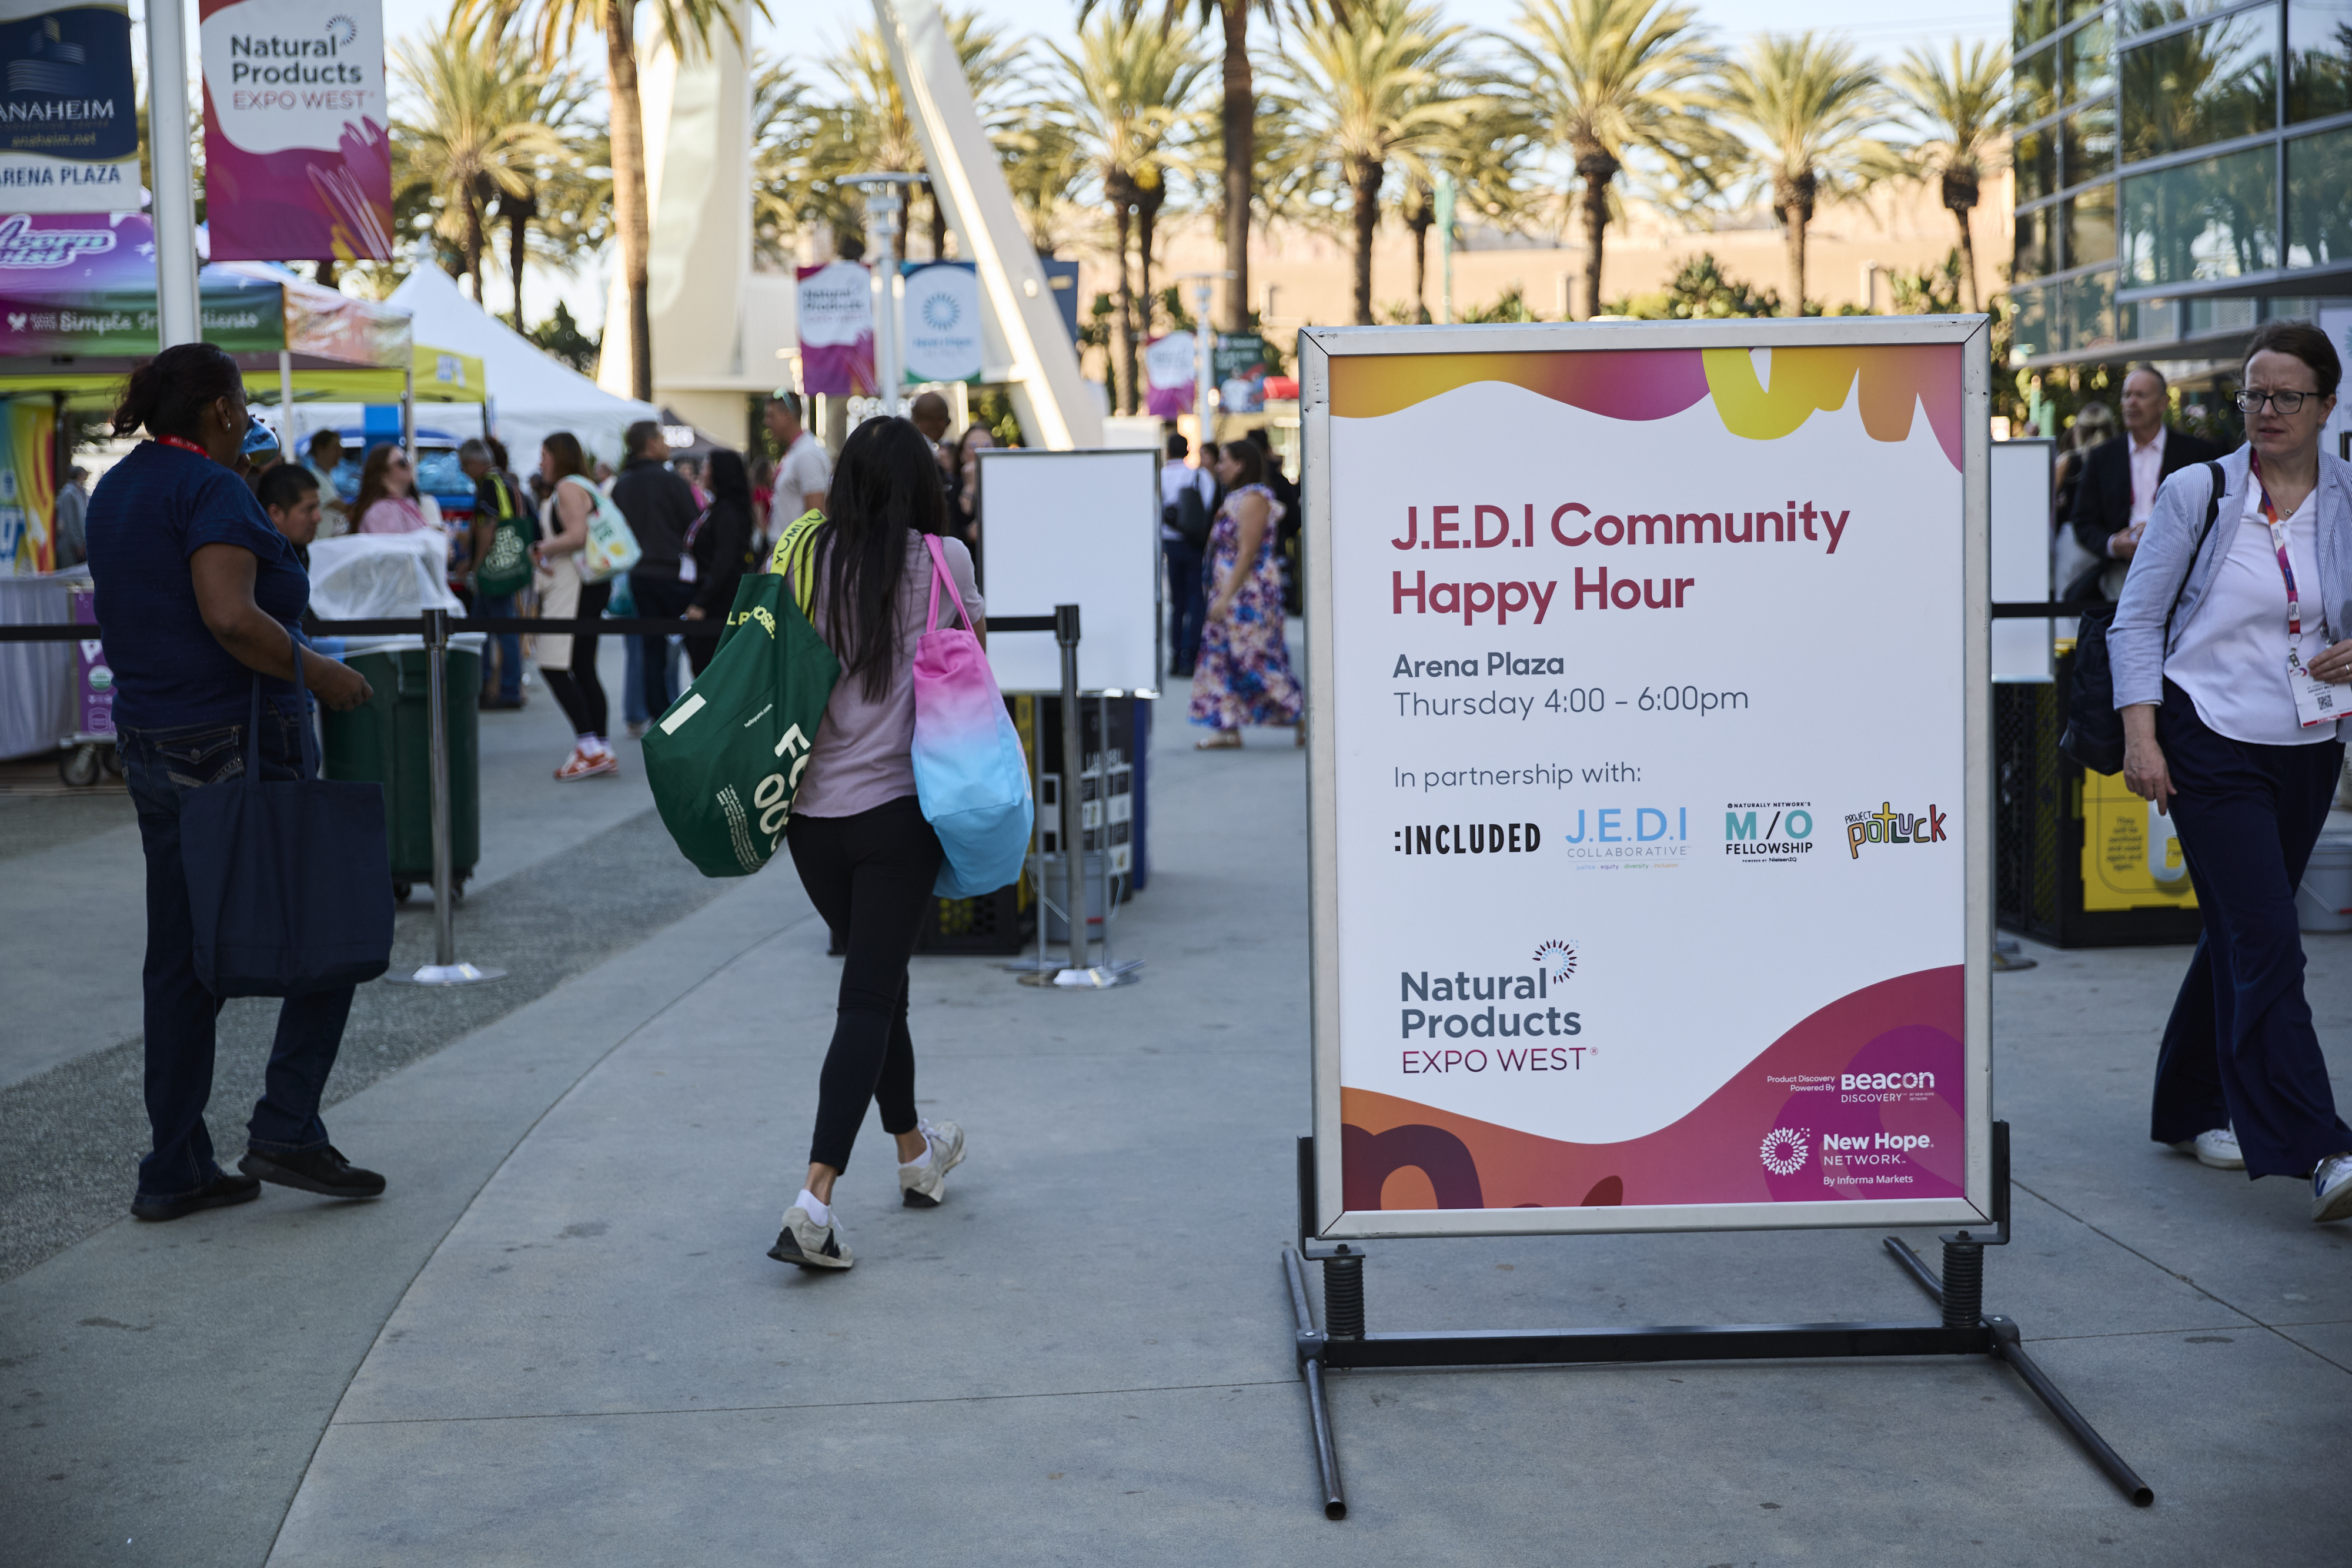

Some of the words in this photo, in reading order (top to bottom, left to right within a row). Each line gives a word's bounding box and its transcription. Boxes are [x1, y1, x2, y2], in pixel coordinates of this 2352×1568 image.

[230, 33, 338, 58] Natural
[230, 61, 363, 85] Products
[233, 90, 296, 111] EXPO
[0, 166, 54, 187] RENA
[60, 163, 122, 185] PLAZA
[60, 311, 132, 336] Simple
[1391, 503, 1534, 551] J.E.D.I
[1551, 500, 1850, 554] Community
[775, 524, 803, 564] YUMI
[1392, 570, 1558, 626] Happy
[1574, 566, 1695, 610] Hour
[1393, 654, 1479, 678] Arena
[1487, 651, 1564, 676] Plaza
[1394, 690, 1534, 720] Thursday
[1544, 688, 1605, 714] 4:00
[1638, 686, 1749, 717] 6:00pm
[1395, 767, 1415, 787] In
[1425, 763, 1573, 793] partnership
[1582, 762, 1641, 783] with:
[1565, 807, 1686, 844] J.E.D.I
[1845, 811, 1872, 824] PROJECT
[1726, 842, 1813, 855] FELLOWSHIP
[1401, 968, 1546, 1001] Natural
[1402, 1006, 1581, 1038] Products
[1403, 1049, 1487, 1074] EXPO
[1790, 1084, 1824, 1092] Powered
[1799, 1075, 1835, 1083] Discovery
[1841, 1093, 1902, 1103] DISCOVERY
[1823, 1134, 1869, 1151] New
[1823, 1176, 1835, 1186] By
[1838, 1176, 1874, 1184] Informa
[1876, 1175, 1913, 1183] Markets
